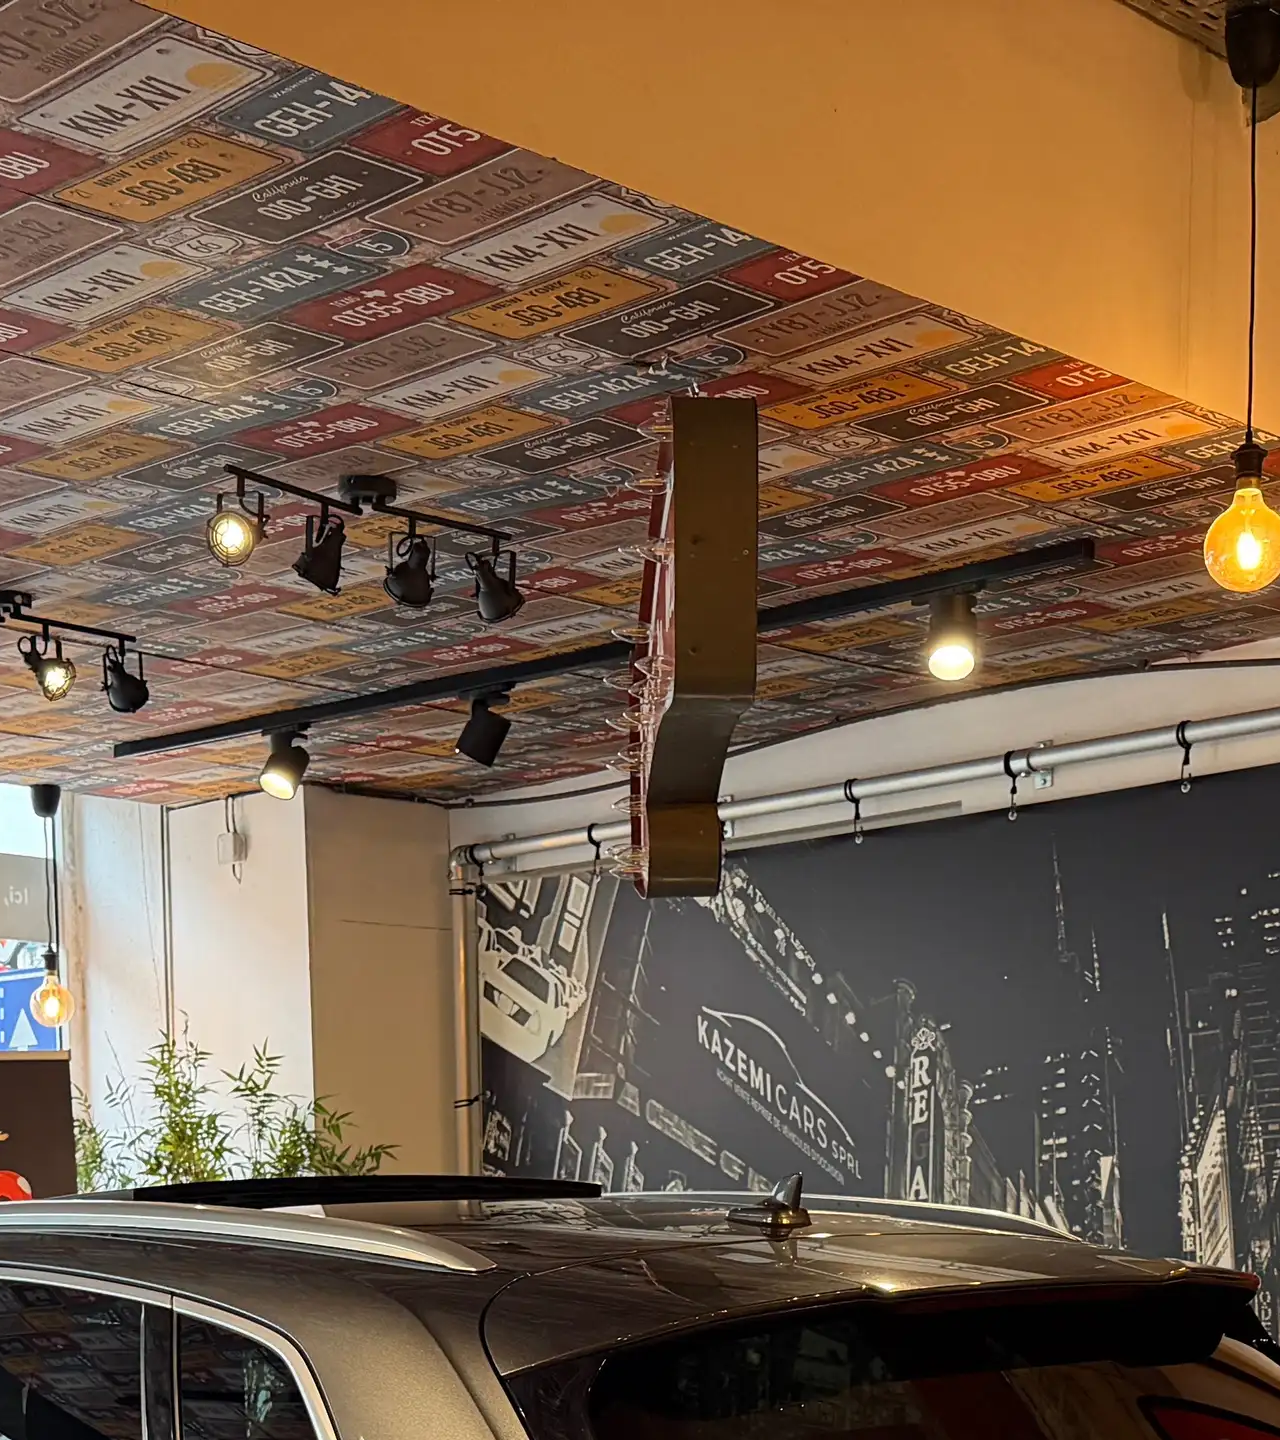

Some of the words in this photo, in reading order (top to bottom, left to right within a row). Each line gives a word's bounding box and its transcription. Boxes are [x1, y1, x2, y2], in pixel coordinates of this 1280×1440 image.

[252, 80, 372, 143] GEH-14
[94, 169, 133, 188] NEW
[128, 149, 179, 170] YORK
[643, 226, 753, 273] GEH-14
[697, 1015, 771, 1102] KAZEMI
[775, 1084, 827, 1148] CARS
[831, 1140, 862, 1180] SPRL
